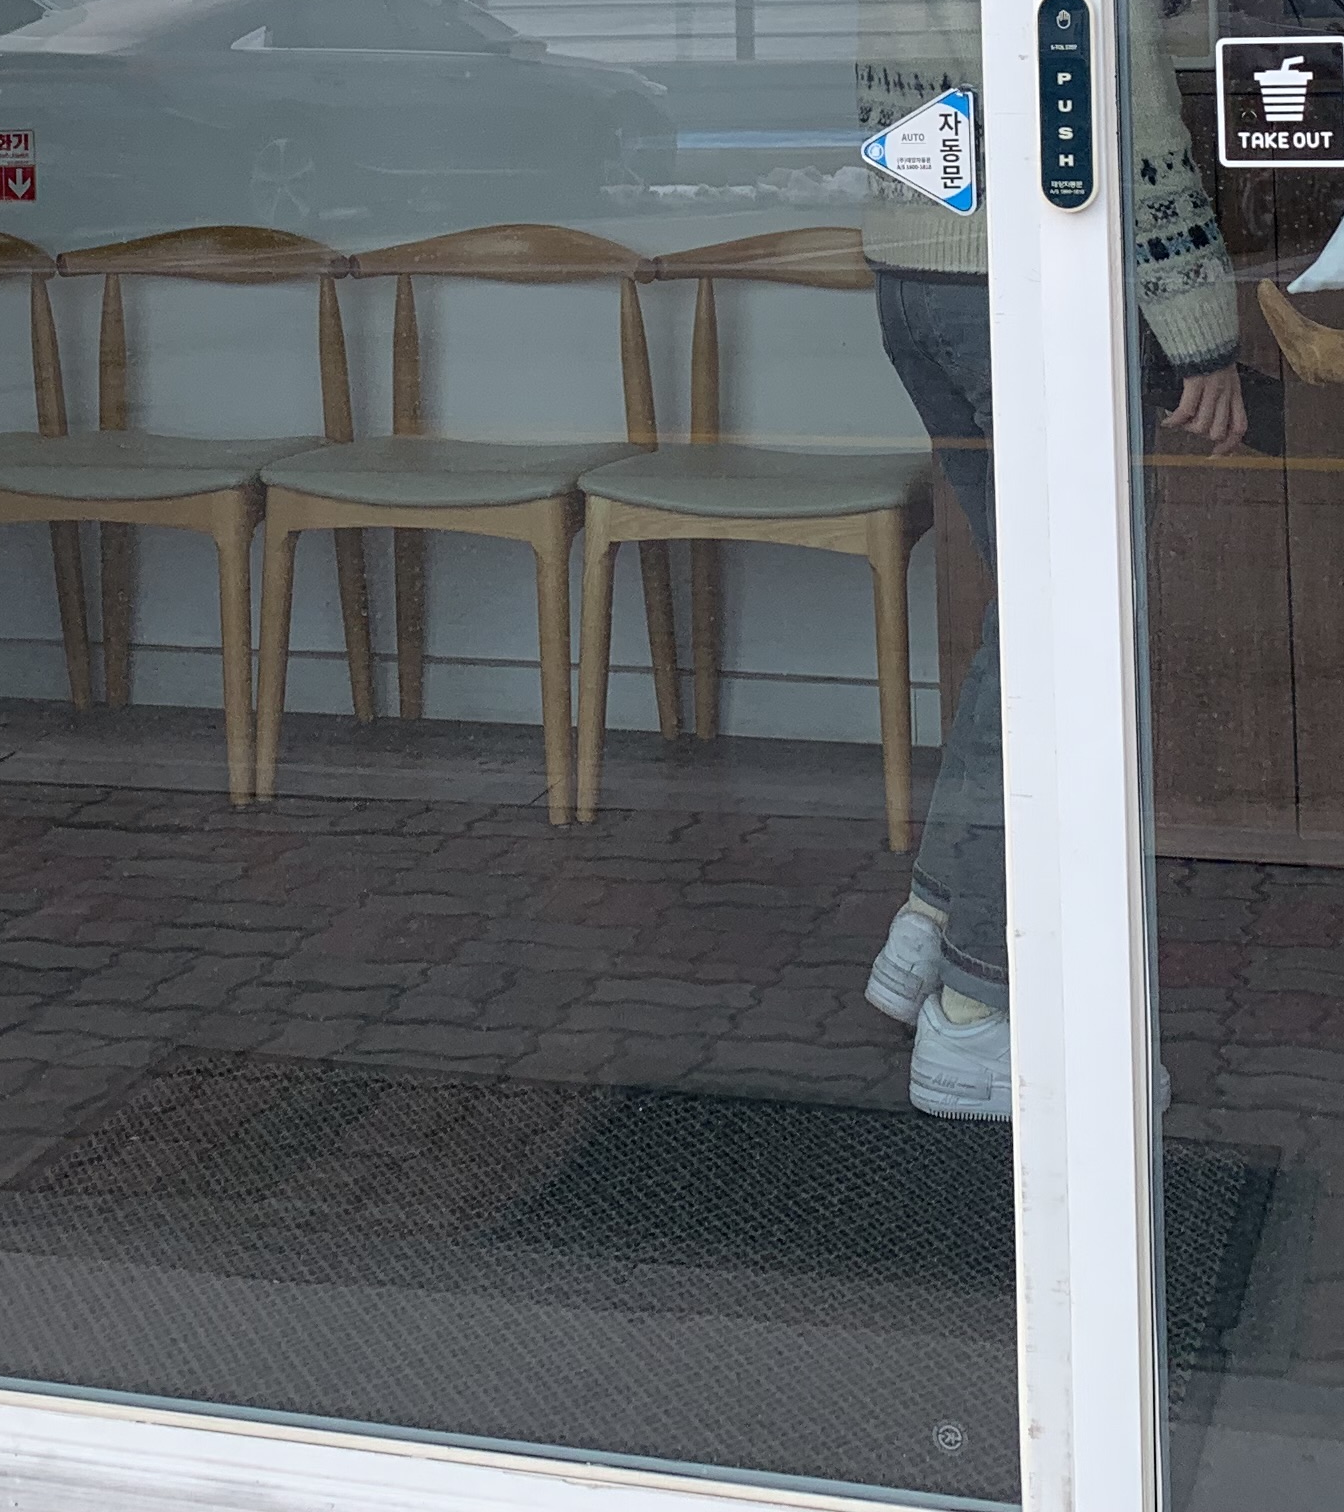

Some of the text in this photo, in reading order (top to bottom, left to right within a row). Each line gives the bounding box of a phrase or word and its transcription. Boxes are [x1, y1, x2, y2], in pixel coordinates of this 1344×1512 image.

[901, 133, 925, 142] AUTO
[1057, 71, 1075, 169] PUSH
[1238, 131, 1334, 150] TAKE OUT
[939, 111, 963, 190] 자동문
